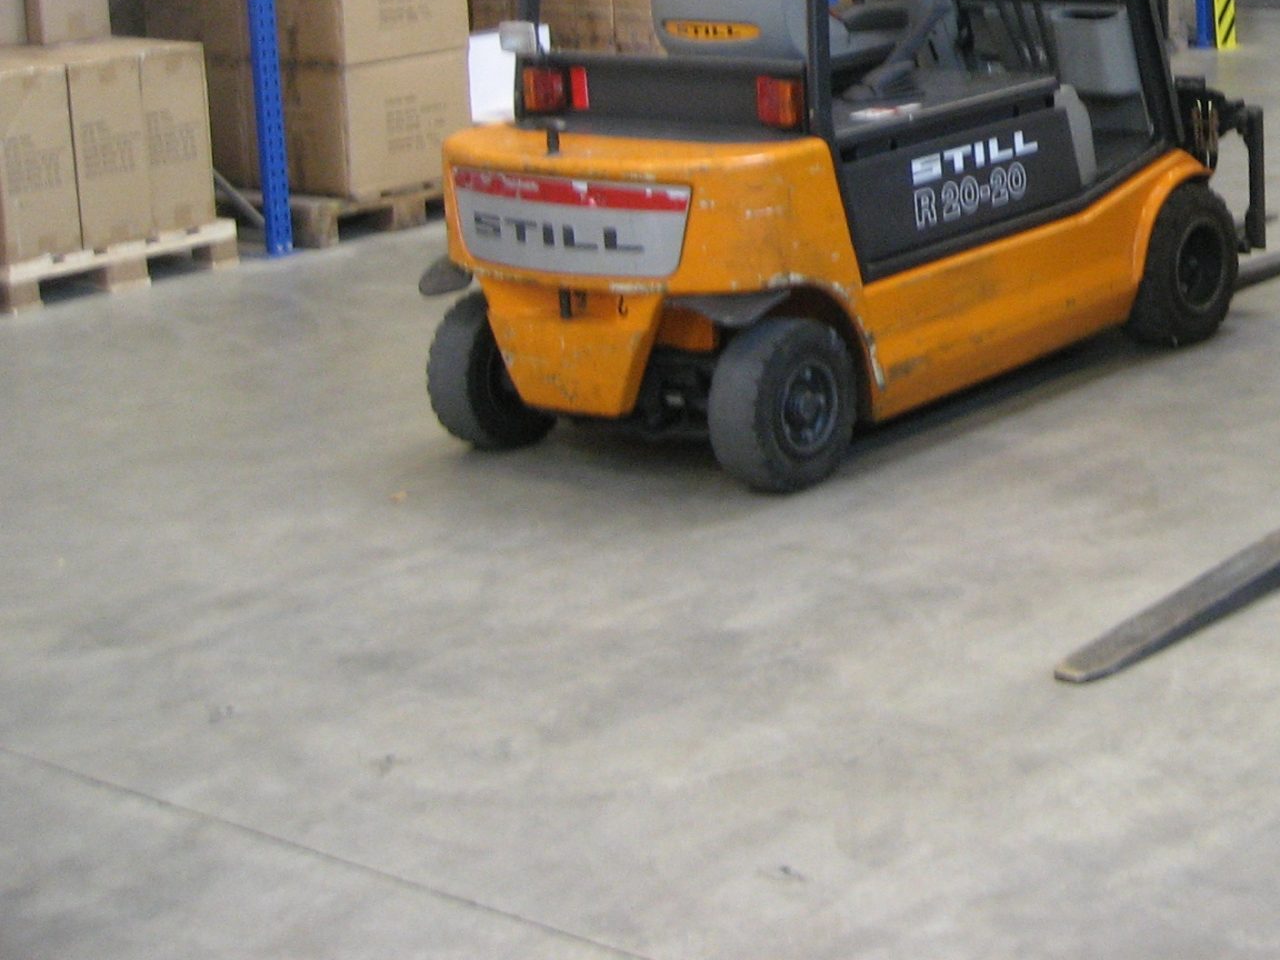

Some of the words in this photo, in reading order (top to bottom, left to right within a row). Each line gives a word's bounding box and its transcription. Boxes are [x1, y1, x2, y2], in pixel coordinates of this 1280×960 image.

[676, 24, 740, 37] STILL
[911, 130, 1038, 187] STILL
[914, 187, 938, 230] R
[941, 161, 1027, 223] 20-20
[474, 209, 645, 252] STILL
